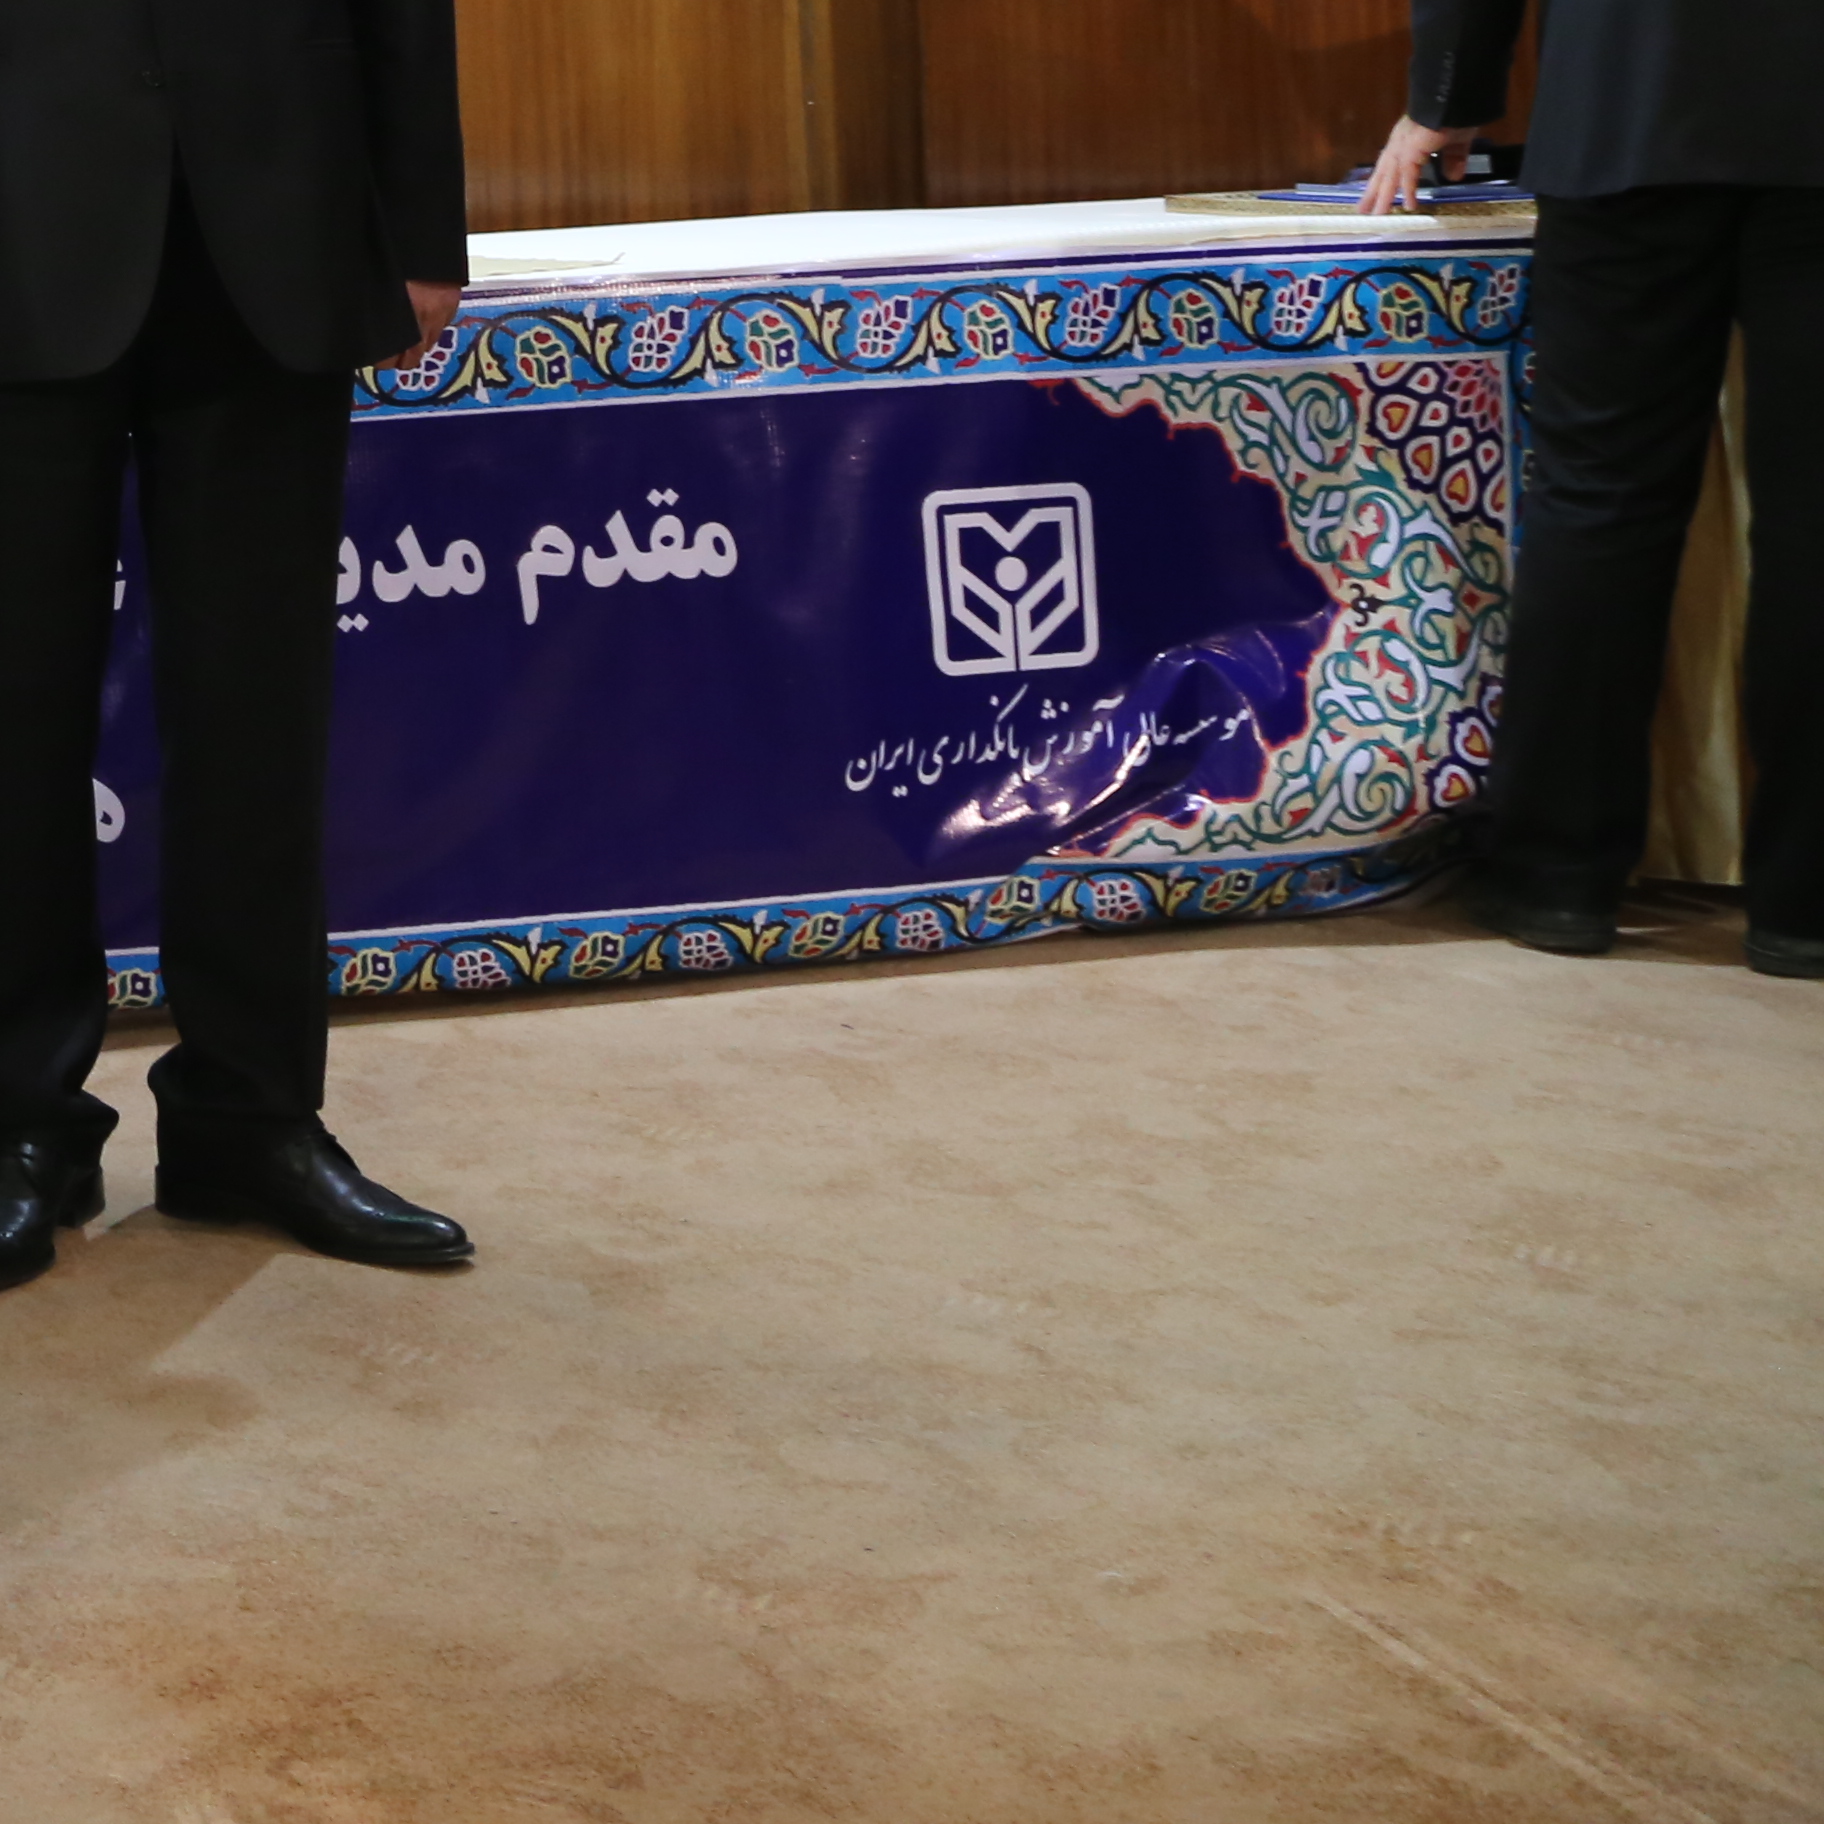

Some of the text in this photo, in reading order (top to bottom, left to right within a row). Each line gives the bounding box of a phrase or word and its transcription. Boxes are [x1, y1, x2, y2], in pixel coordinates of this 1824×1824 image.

[517, 488, 738, 625] مقدم
[844, 737, 915, 797] ایران
[1023, 693, 1126, 776] آموزش
